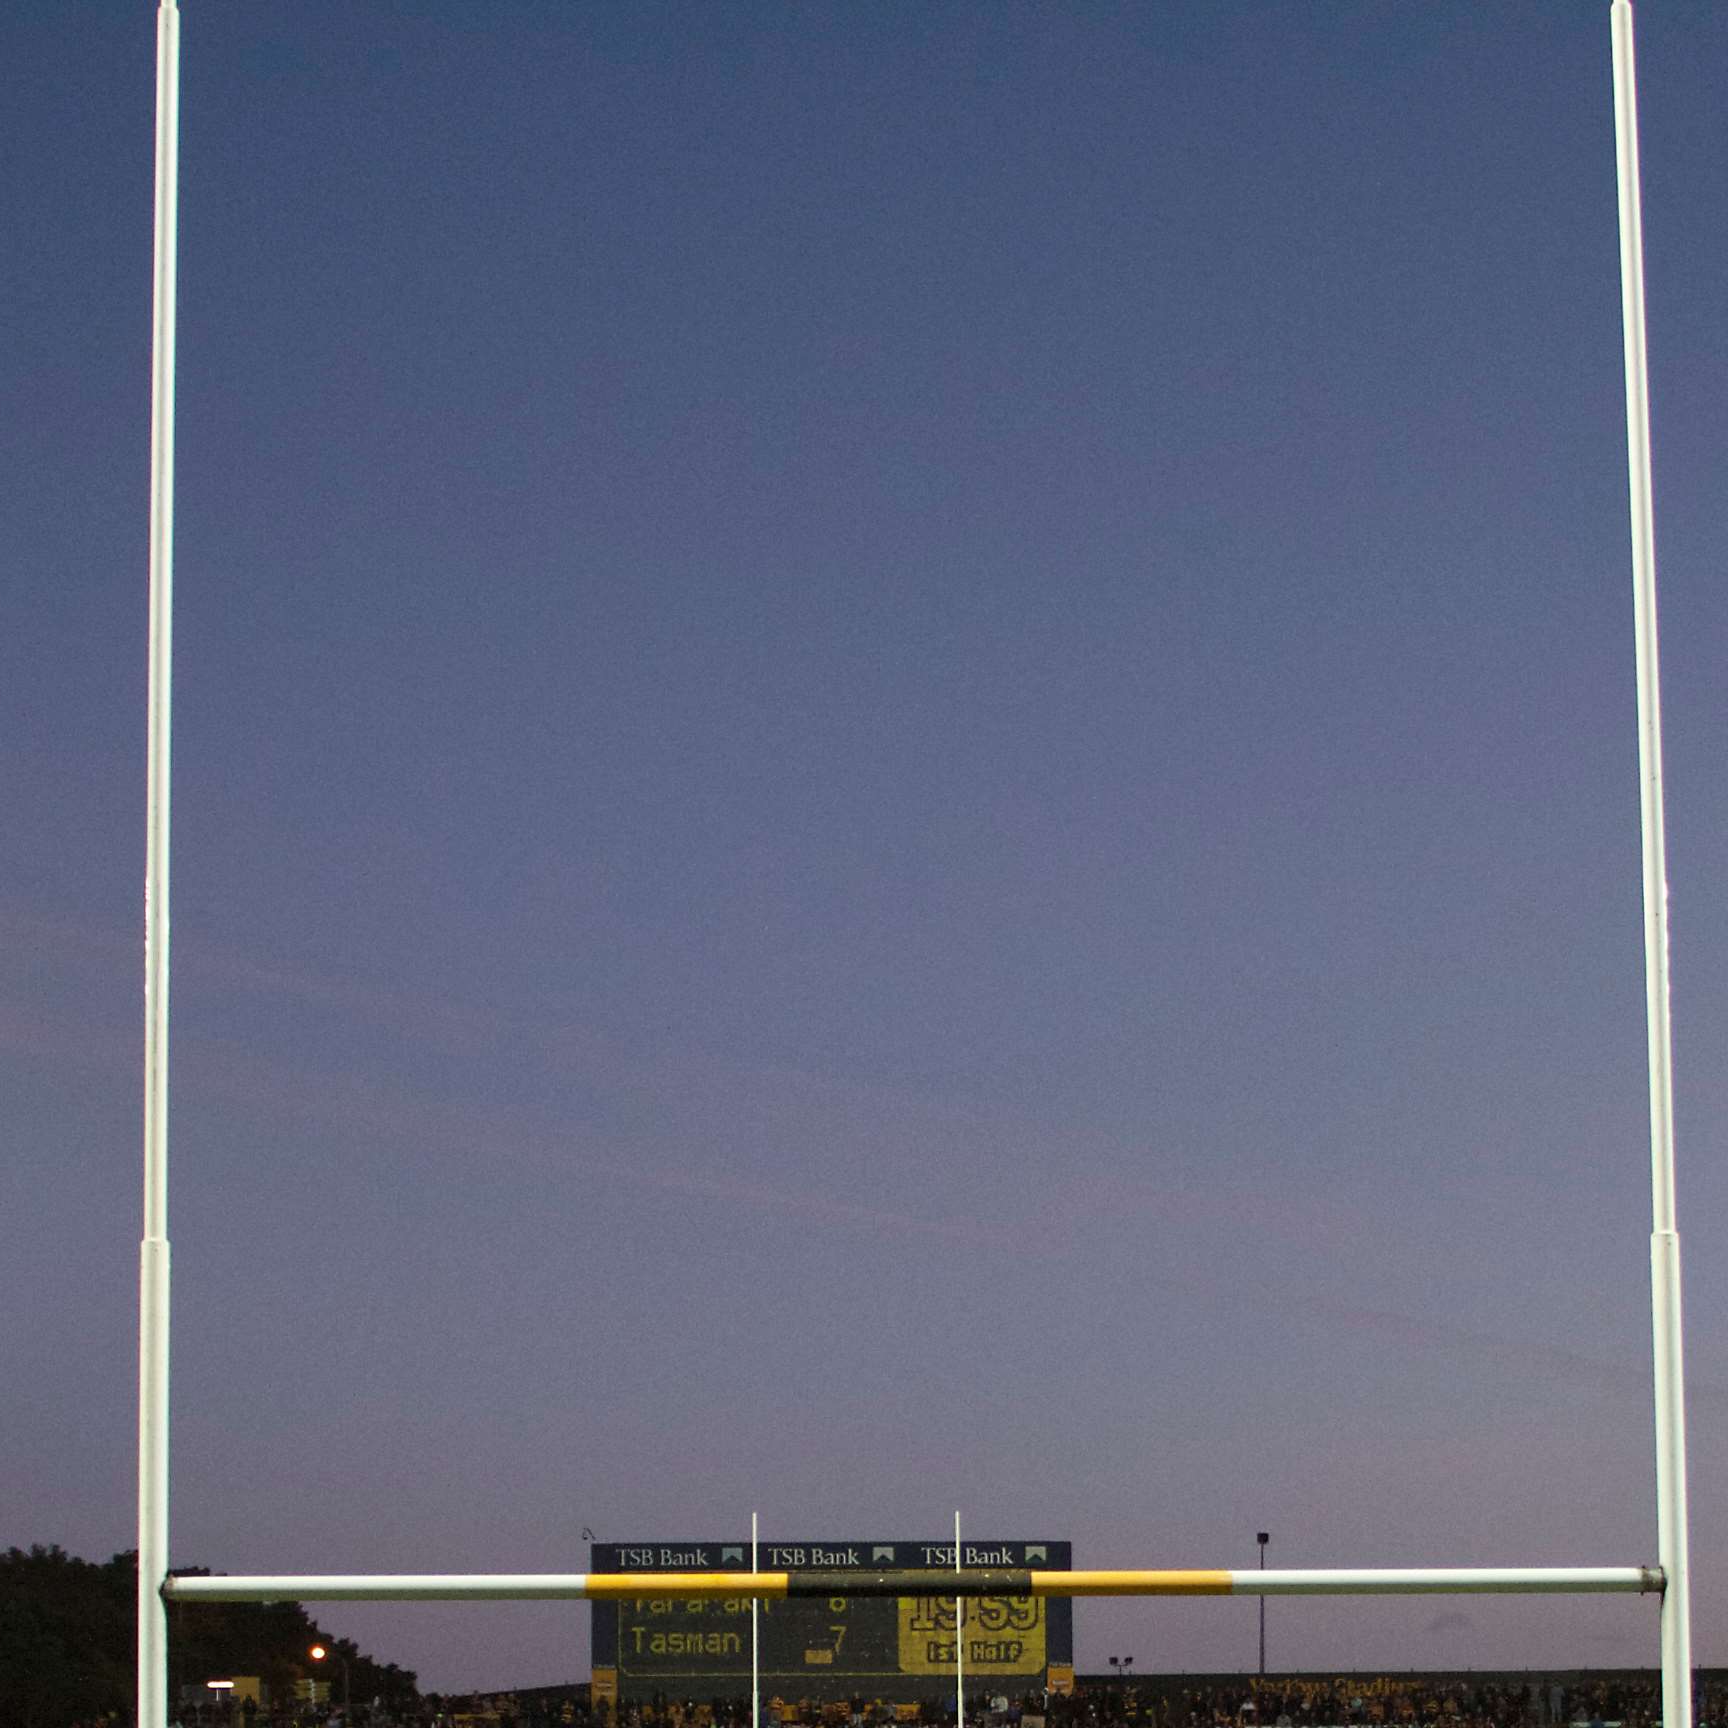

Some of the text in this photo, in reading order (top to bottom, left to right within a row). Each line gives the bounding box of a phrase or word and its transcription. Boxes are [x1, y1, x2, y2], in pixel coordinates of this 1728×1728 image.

[616, 1547, 709, 1567] TSB Bank
[768, 1547, 860, 1566] TSB Bank
[921, 1547, 1014, 1565] TSB Bank
[632, 1625, 847, 1655] Tasman 7
[970, 1641, 1023, 1663] Half
